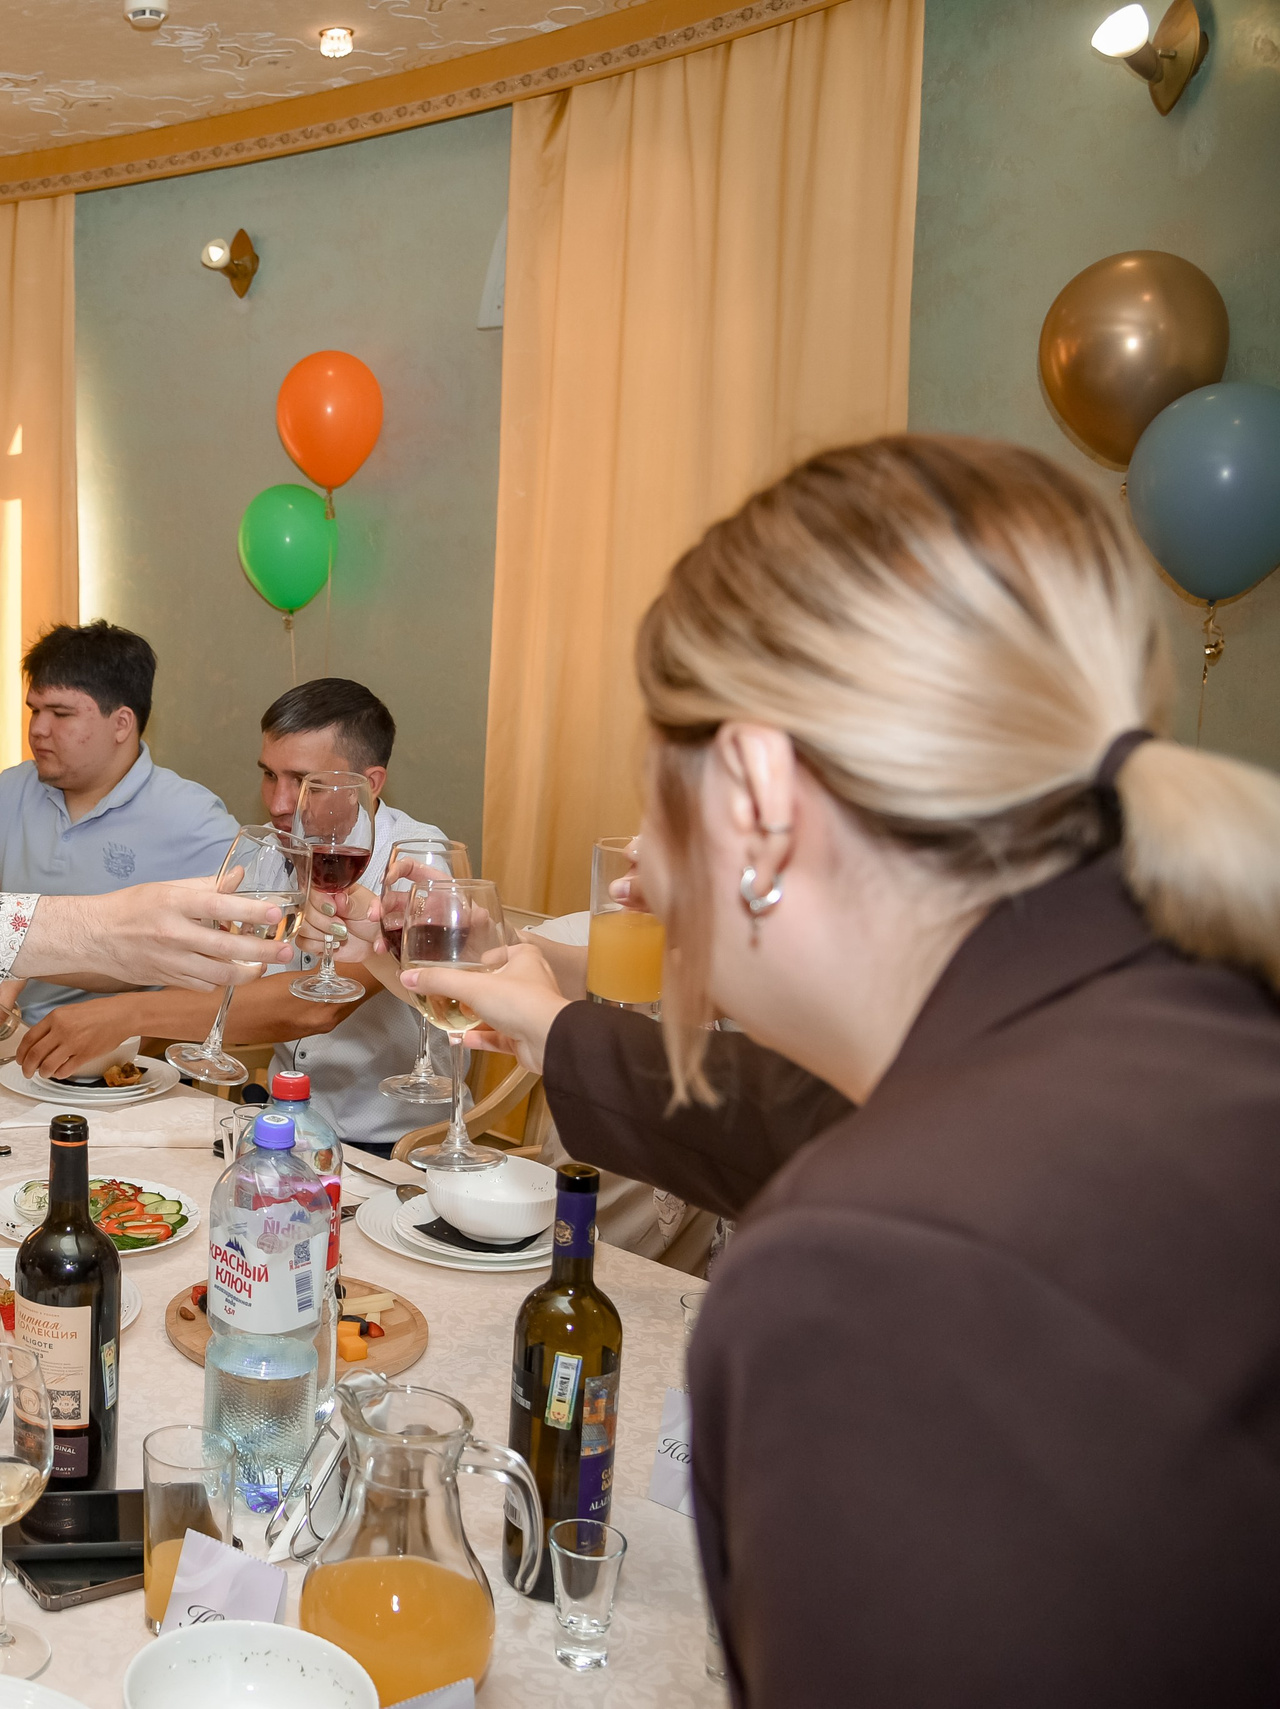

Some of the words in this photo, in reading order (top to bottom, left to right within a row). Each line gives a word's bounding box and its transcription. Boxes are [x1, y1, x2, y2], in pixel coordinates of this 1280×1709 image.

[209, 1240, 269, 1283] КРАСНЫЙ
[215, 1265, 252, 1299] КЛЮЧ
[22, 1335, 54, 1349] ALIGOTE
[54, 1444, 76, 1455] GINAL
